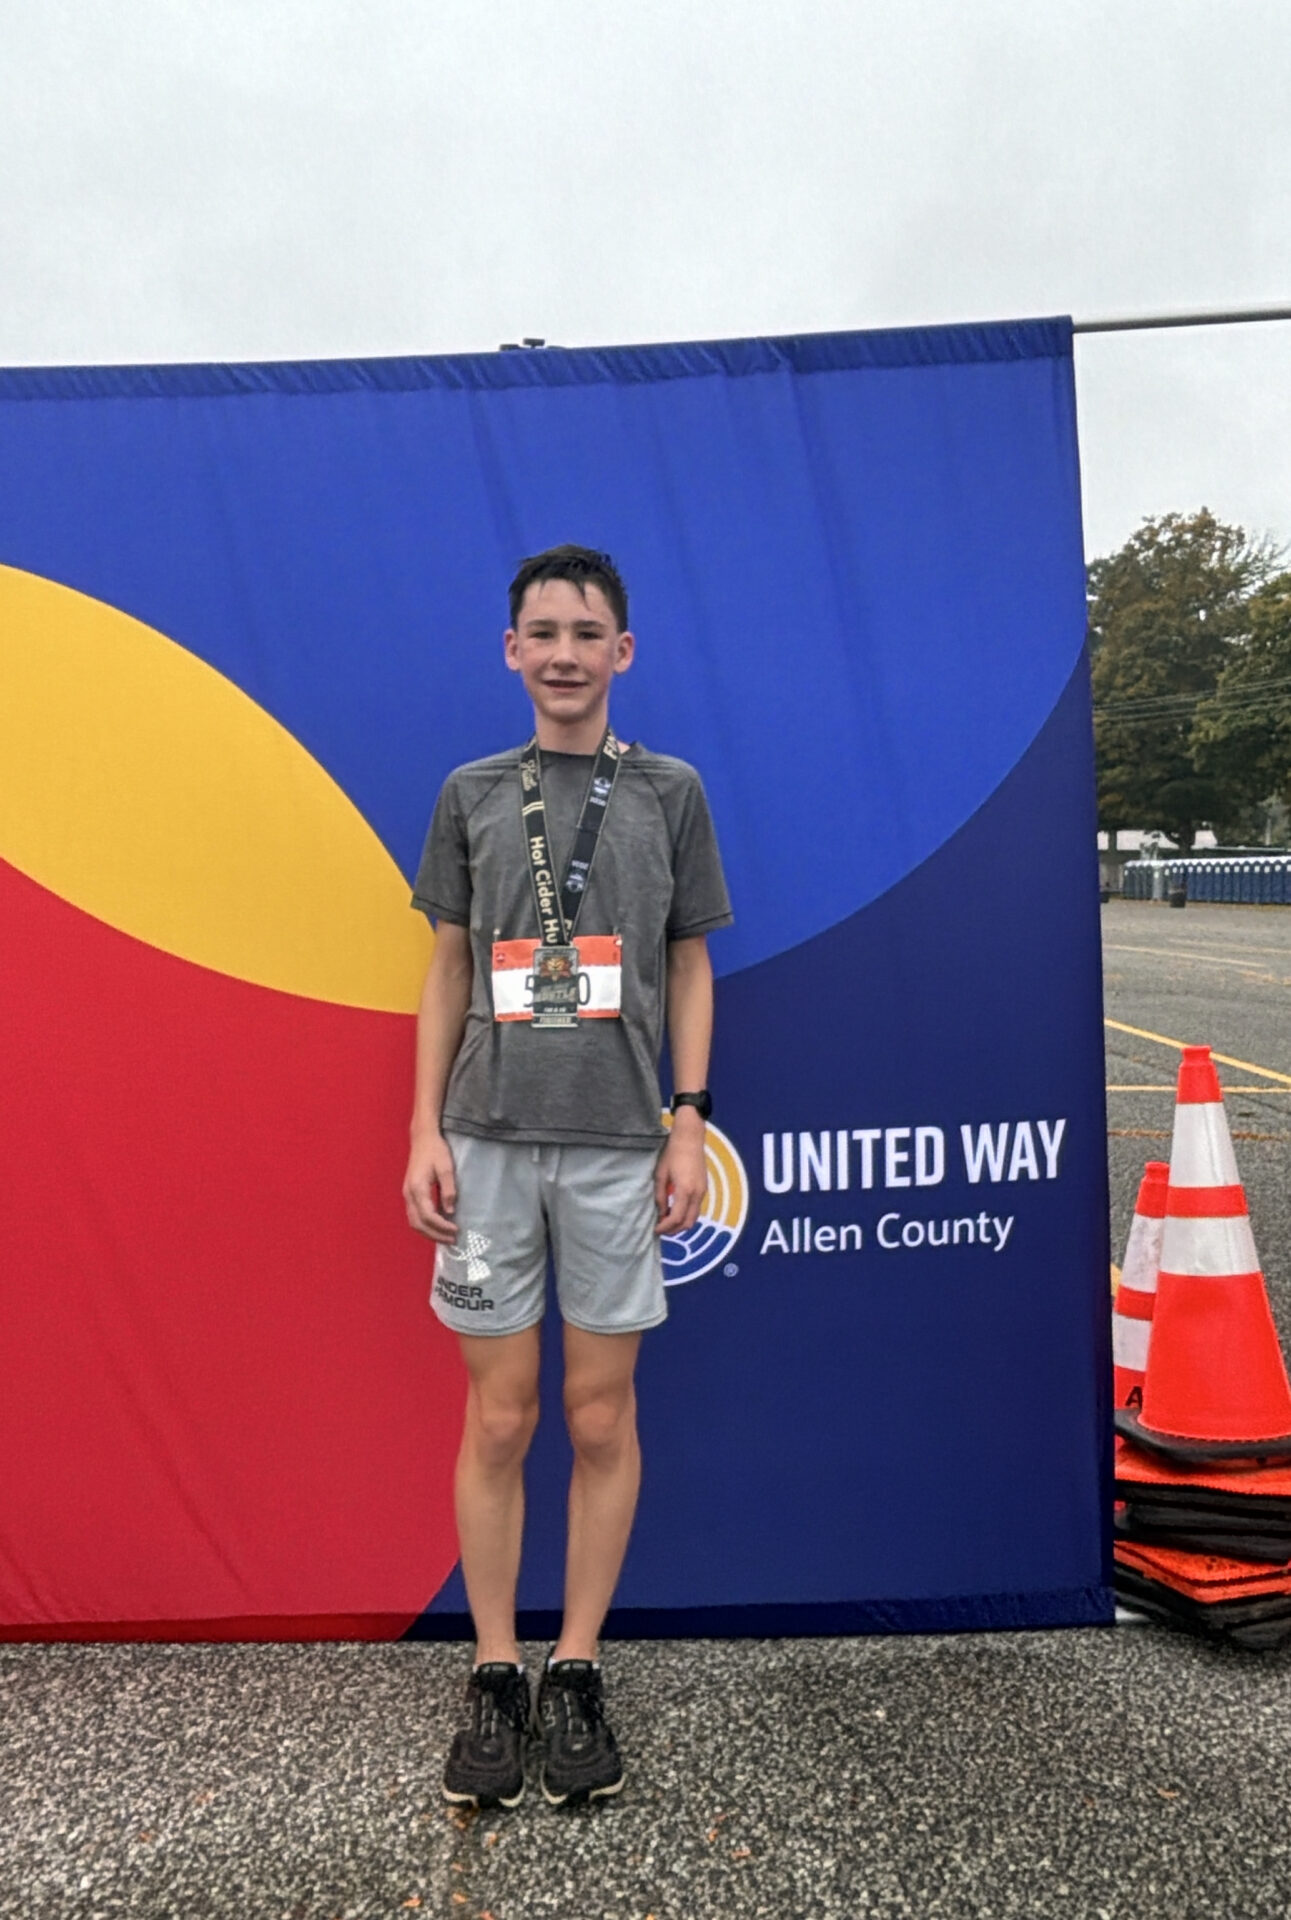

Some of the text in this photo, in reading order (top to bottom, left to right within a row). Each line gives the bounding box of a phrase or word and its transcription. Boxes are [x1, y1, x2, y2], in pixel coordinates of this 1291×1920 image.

[530, 836, 546, 866] Hot
[535, 869, 555, 916] Cider
[523, 971, 591, 1008] 50
[762, 1118, 1066, 1194] UNITED WAY
[760, 1211, 1014, 1255] Allen County
